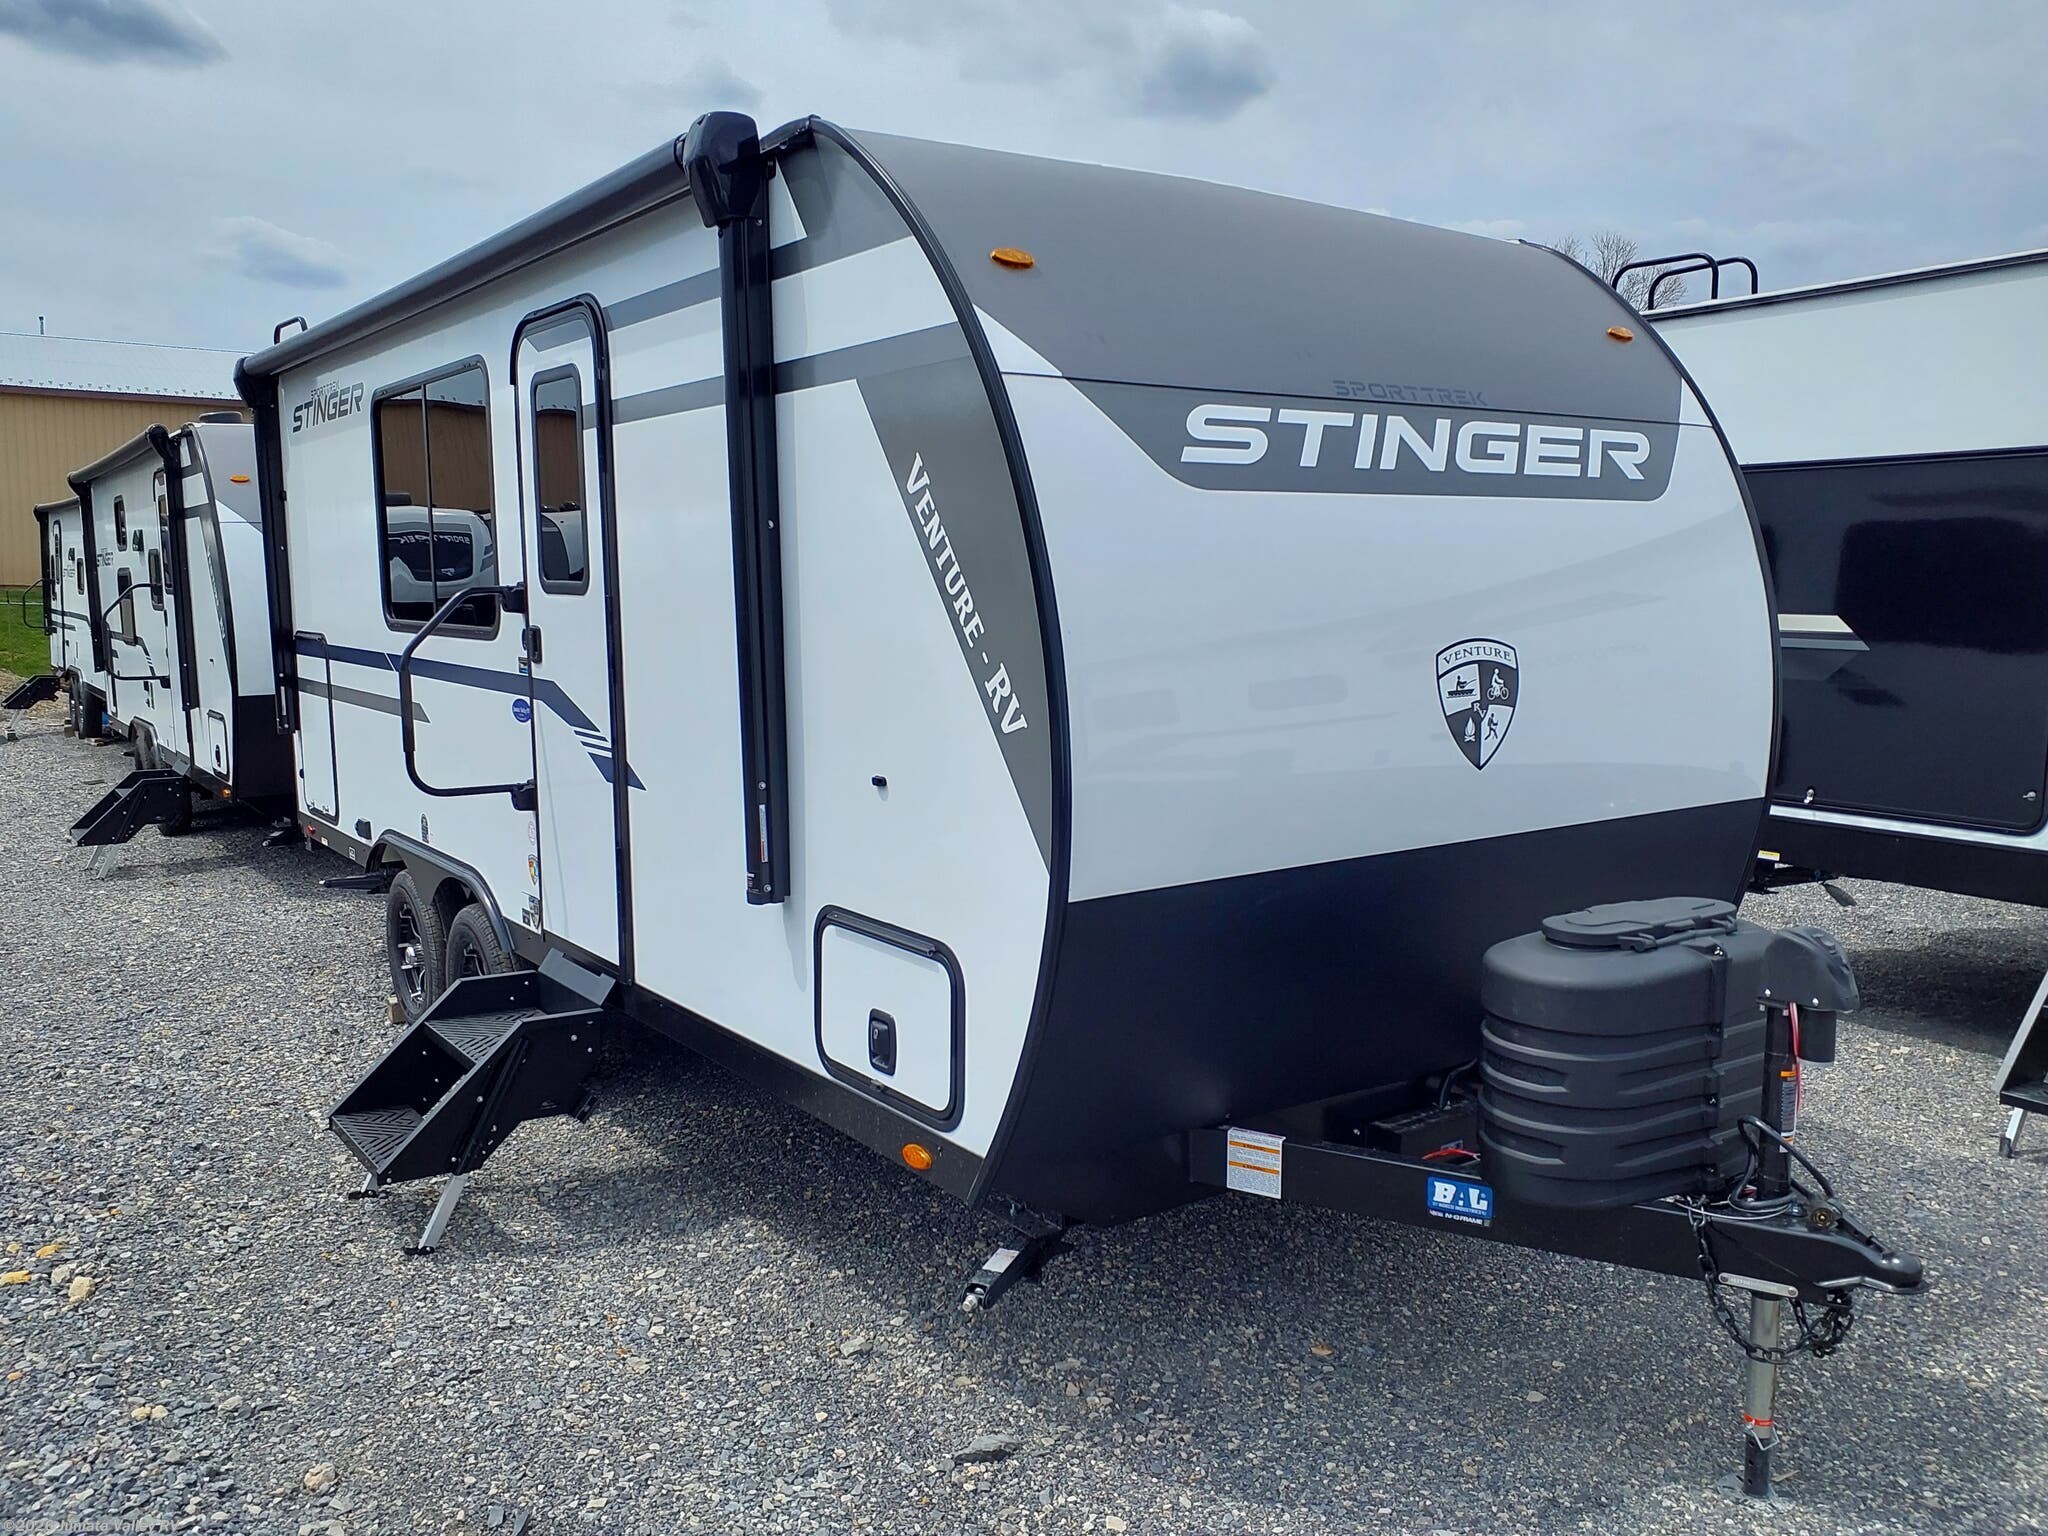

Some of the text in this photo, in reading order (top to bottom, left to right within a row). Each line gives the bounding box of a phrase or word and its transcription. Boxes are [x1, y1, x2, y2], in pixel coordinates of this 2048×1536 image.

[292, 382, 365, 433] STINGER
[1333, 380, 1488, 406] SPORTTREK
[1180, 403, 1652, 480] STINGER
[1443, 646, 1512, 664] VENTURE
[984, 662, 1029, 736] RV
